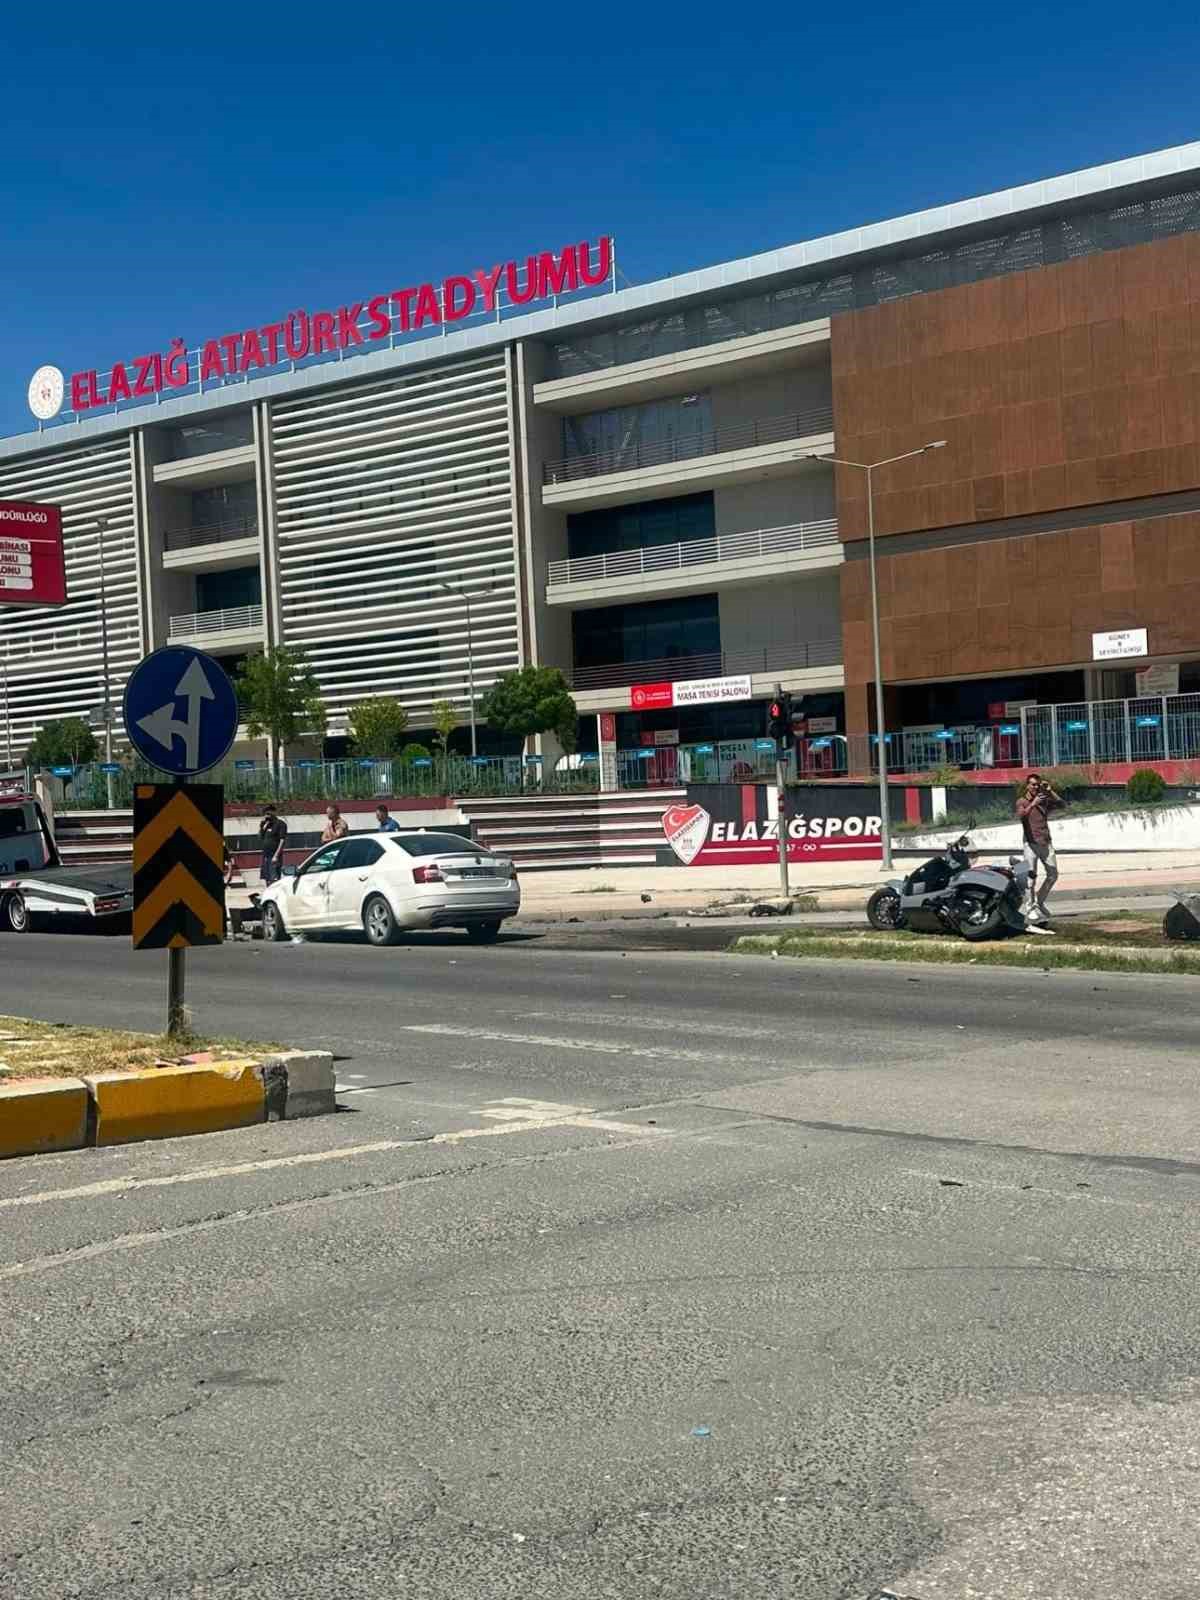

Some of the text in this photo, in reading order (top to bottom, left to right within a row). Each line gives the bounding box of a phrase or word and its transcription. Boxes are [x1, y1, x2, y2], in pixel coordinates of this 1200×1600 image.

[71, 235, 609, 411] ELAZIĞ ATATÜRK STADYUMU
[711, 814, 882, 842] ELAZĞSPOR
